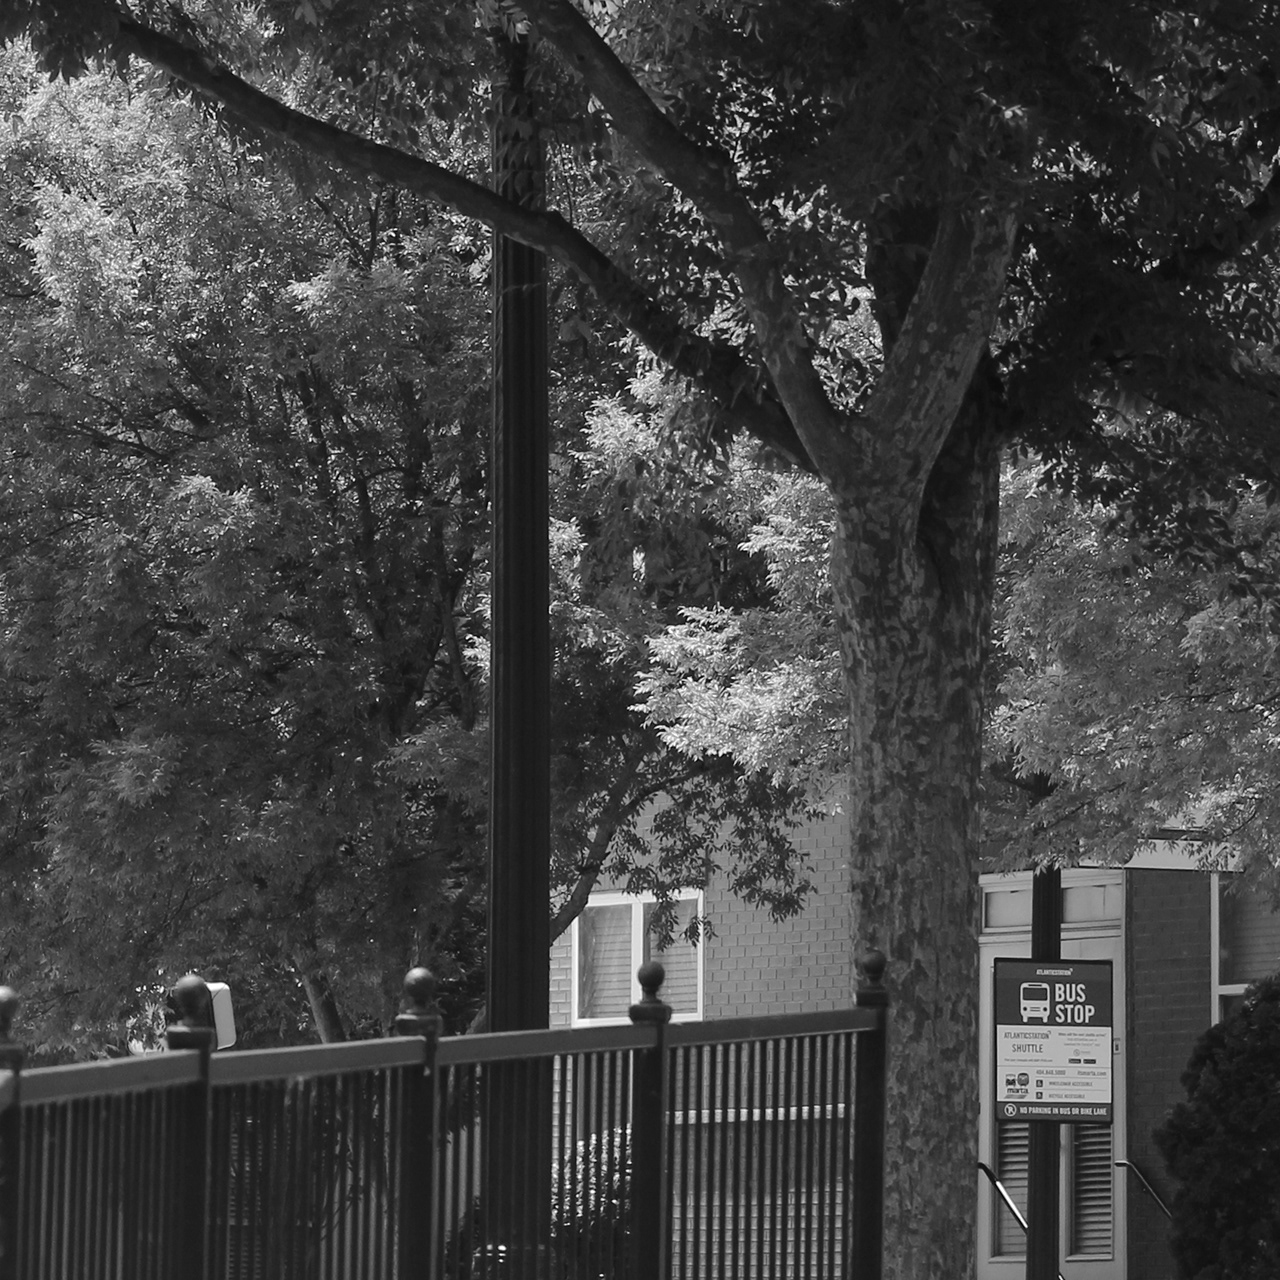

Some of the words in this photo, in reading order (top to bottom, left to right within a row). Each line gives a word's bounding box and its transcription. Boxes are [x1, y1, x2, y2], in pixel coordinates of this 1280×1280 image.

[1055, 983, 1086, 1003] BUS
[1055, 1004, 1095, 1023] STOP
[1004, 1031, 1050, 1040] ATLANTICSTATION
[1012, 1043, 1044, 1053] SHUTTLE
[1060, 1107, 1071, 1115] BUS
[1071, 1107, 1079, 1115] OR
[1080, 1107, 1092, 1115] BIKE
[1093, 1107, 1107, 1116] LANE
